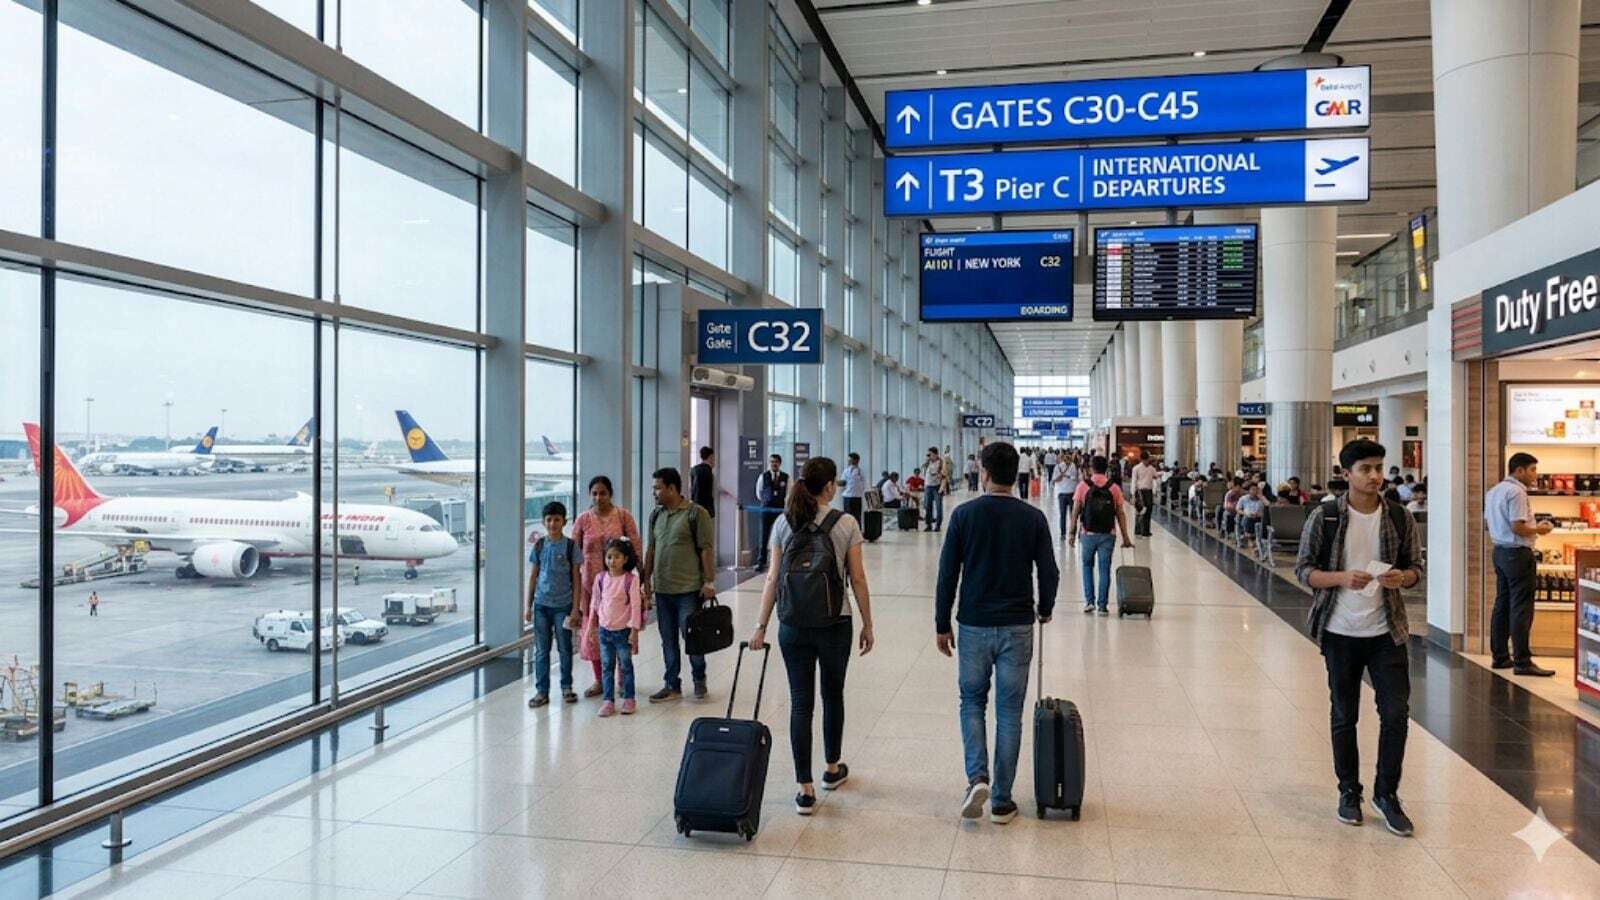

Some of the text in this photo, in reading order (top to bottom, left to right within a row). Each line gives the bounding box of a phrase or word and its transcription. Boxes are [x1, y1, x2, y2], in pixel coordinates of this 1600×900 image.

[951, 91, 1199, 130] GATES C30-C45
[1315, 99, 1361, 116] GMR
[1093, 152, 1261, 176] INTERNATIONAL
[940, 168, 1070, 202] T3 Pier C
[1093, 178, 1226, 198] DEPARTURES
[924, 247, 956, 257] FLIGHT
[965, 258, 989, 269] NEW
[992, 257, 1021, 268] YORK
[1040, 256, 1061, 267] C32
[1020, 306, 1068, 316] BOARDING
[1496, 275, 1598, 335] Duty Free
[706, 337, 732, 349] Gate
[748, 321, 810, 352] C32
